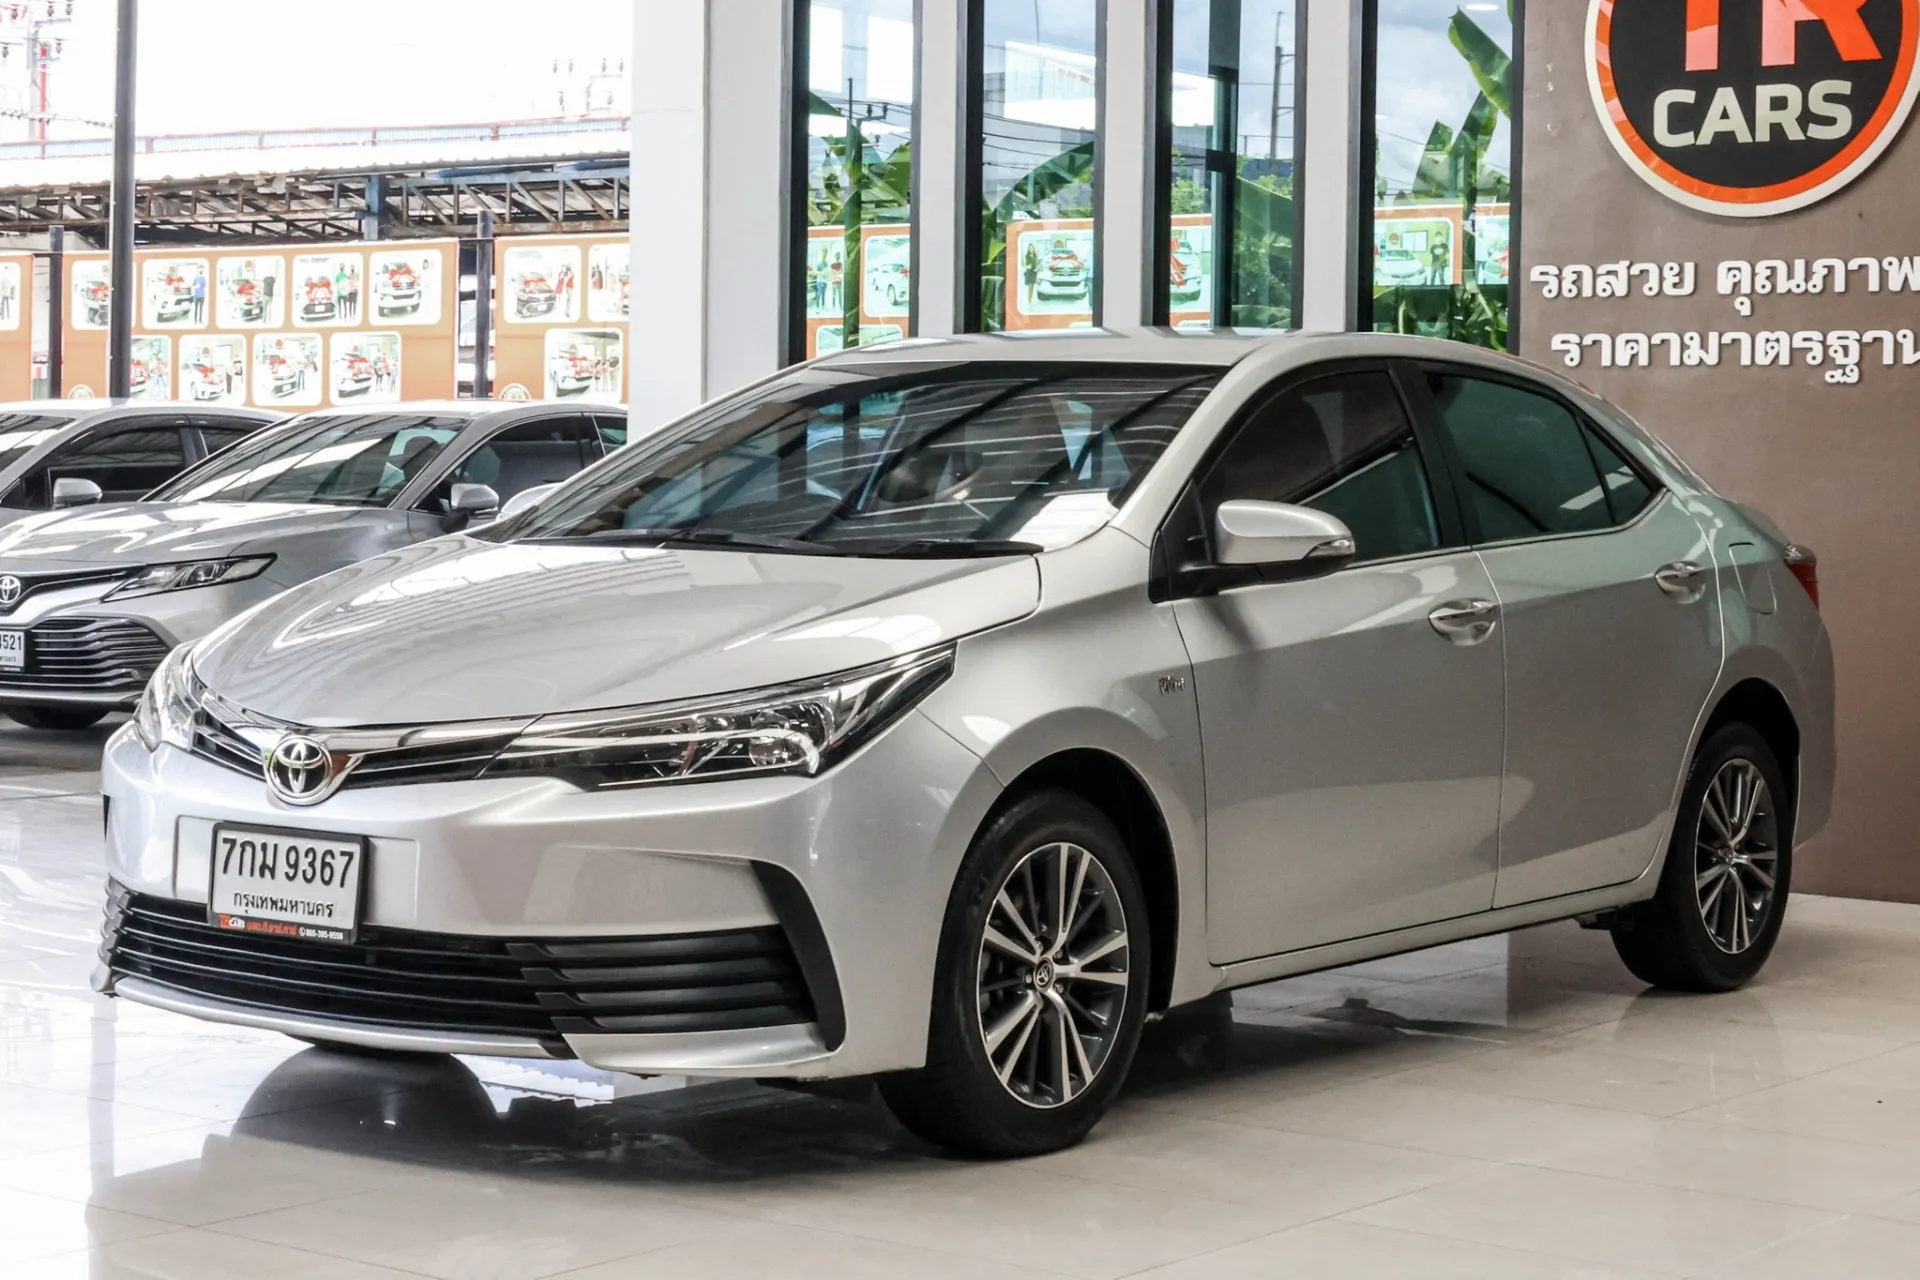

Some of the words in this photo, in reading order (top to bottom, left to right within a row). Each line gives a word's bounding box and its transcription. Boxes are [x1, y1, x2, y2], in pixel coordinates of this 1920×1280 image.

[1653, 79, 1853, 148] CARS
[1529, 260, 1696, 299] รถสวย
[1716, 256, 1920, 316] คุณภาพ
[0, 634, 22, 651] 521
[221, 836, 279, 881] 7กม
[284, 844, 354, 888] 9367
[233, 891, 335, 919] กรุงเทพมหานคร
